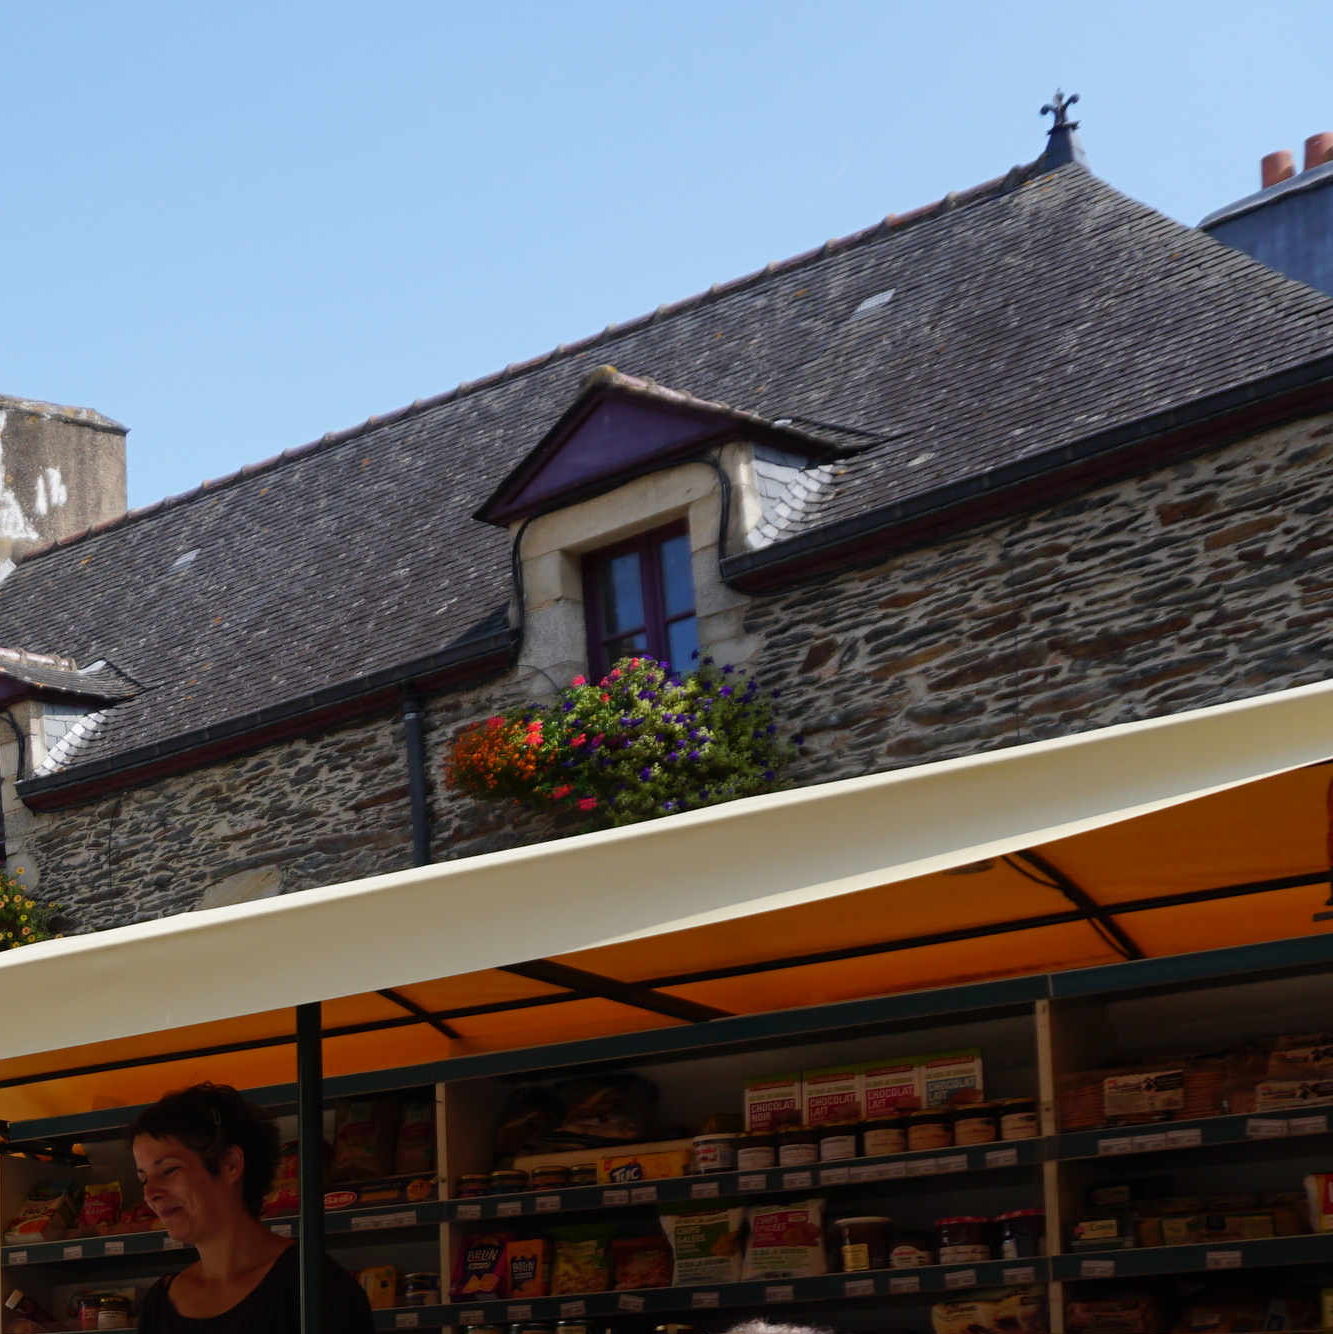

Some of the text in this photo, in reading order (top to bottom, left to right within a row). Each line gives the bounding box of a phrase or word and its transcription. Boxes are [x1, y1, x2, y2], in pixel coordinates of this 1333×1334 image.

[928, 1077, 976, 1092] CHOCOLAT
[867, 1086, 914, 1100] CHOCOLAT
[929, 1091, 948, 1102] LAIT
[809, 1094, 855, 1107] CHOCOLAT
[868, 1099, 886, 1110] LAIT
[751, 1100, 795, 1114] CHOCOLAT
[810, 1106, 828, 1117] LAIT
[751, 1112, 771, 1123] NOIR
[756, 1215, 779, 1225] CHIPS
[676, 1225, 701, 1235] CHIPS
